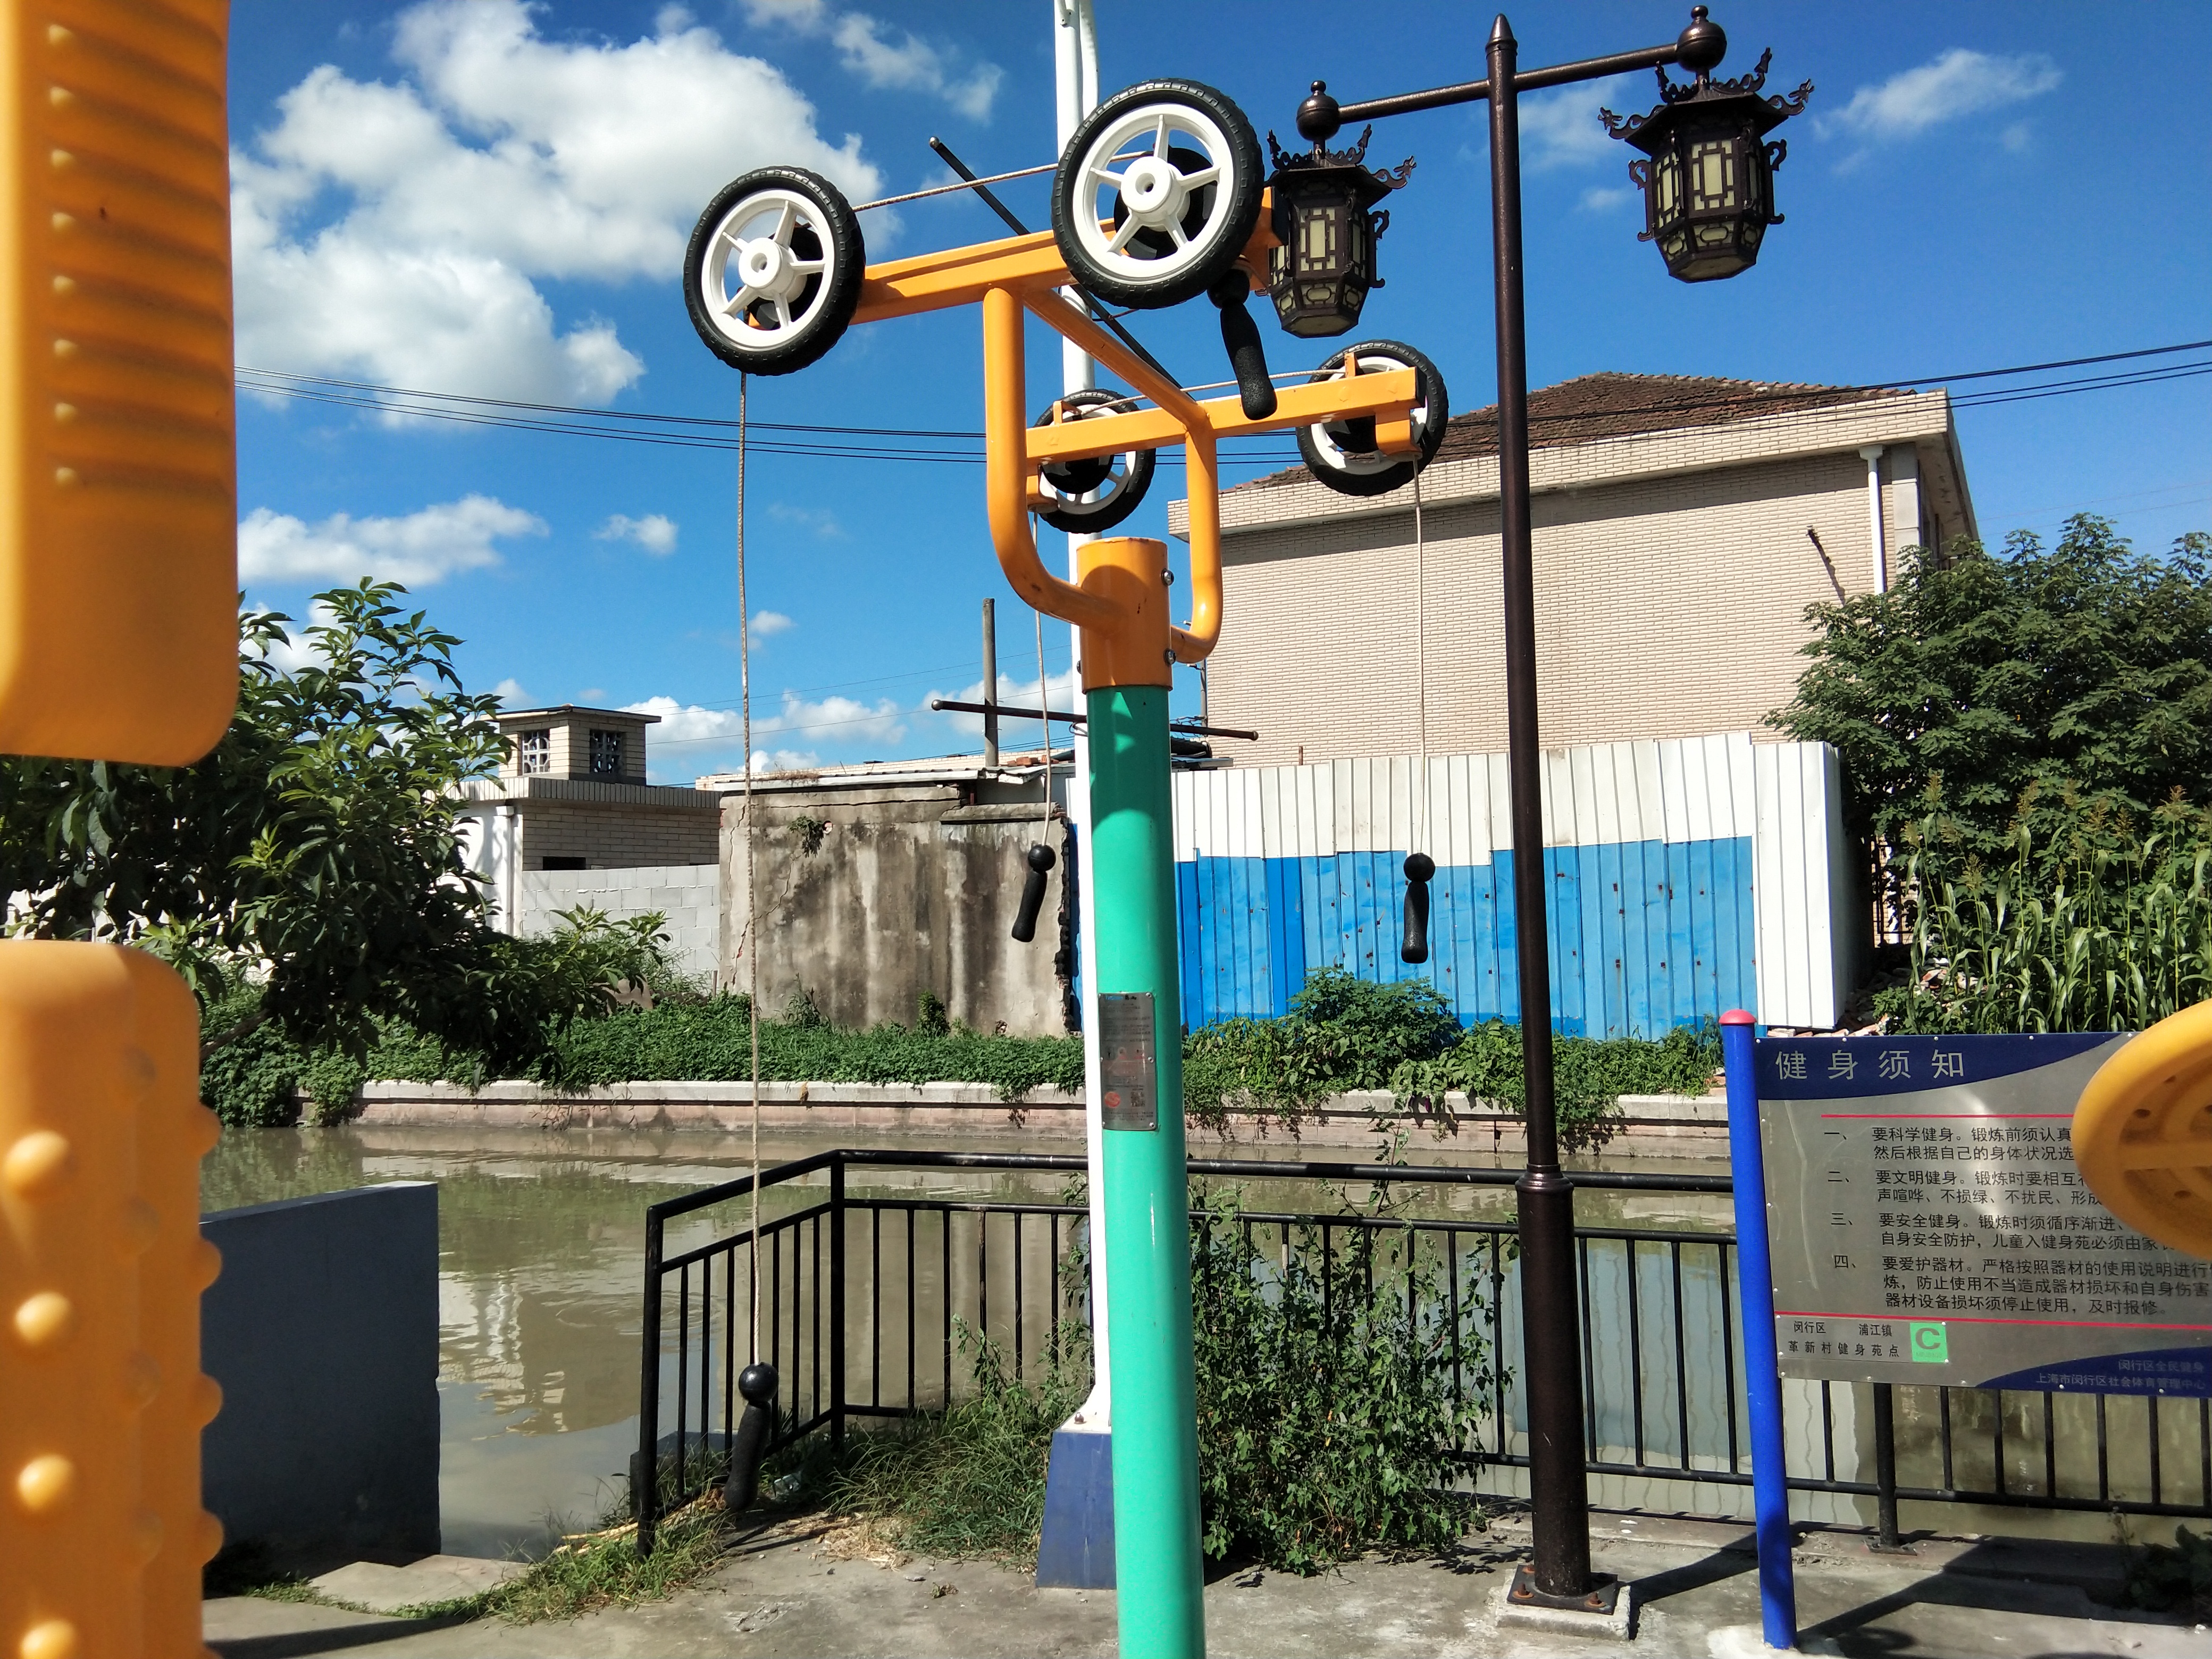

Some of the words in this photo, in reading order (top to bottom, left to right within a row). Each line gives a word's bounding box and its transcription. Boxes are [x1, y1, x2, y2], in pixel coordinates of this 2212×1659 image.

[1775, 1050, 1964, 1079] 健身须知
[1872, 1127, 2072, 1142] 要科学健身。锻炼前须认真
[1874, 1145, 2075, 1161] 然后根据自己的身体状况选
[1828, 1171, 1849, 1183] 二、
[1831, 1213, 1853, 1225] 三、
[1882, 1231, 2175, 1251] 自身安全防护，儿童入健身苑必须由家
[1834, 1255, 1856, 1269] 四、
[1882, 1256, 2212, 1277] 要爱护器材。严格按照器材的使用说明进行
[1886, 1293, 2166, 1316] 器材设备损坏须停止使用，及时报修。
[1794, 1321, 1826, 1334] 闵行区
[1859, 1324, 1892, 1337] 浦江镇
[1915, 1327, 1941, 1350] C
[1788, 1340, 1900, 1357] 革新村健身苑点
[2036, 1373, 2206, 1390] 上海市闵行区社会体育管理中心
